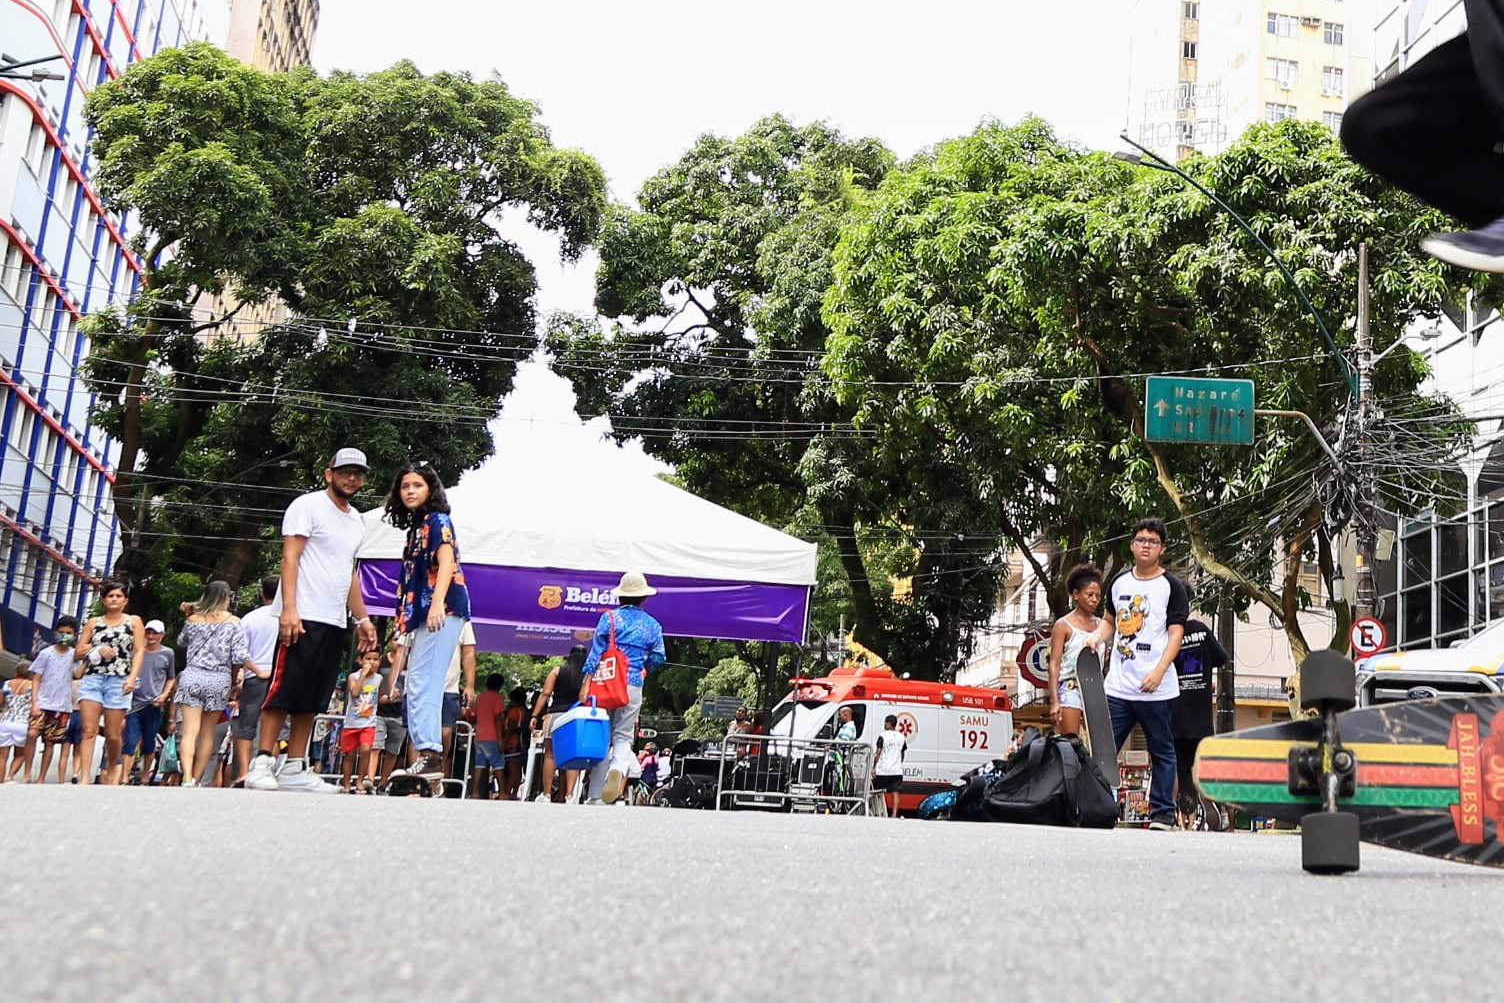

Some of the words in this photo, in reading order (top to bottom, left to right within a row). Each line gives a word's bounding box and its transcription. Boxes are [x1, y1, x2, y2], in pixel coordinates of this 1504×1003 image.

[1139, 118, 1227, 149] HOTEL
[1175, 387, 1240, 401] Nazaré
[1361, 625, 1374, 647] E
[960, 715, 989, 726] SAMU
[960, 729, 989, 749] 192
[1457, 721, 1476, 759] JAH
[1461, 765, 1479, 827] BLESS
